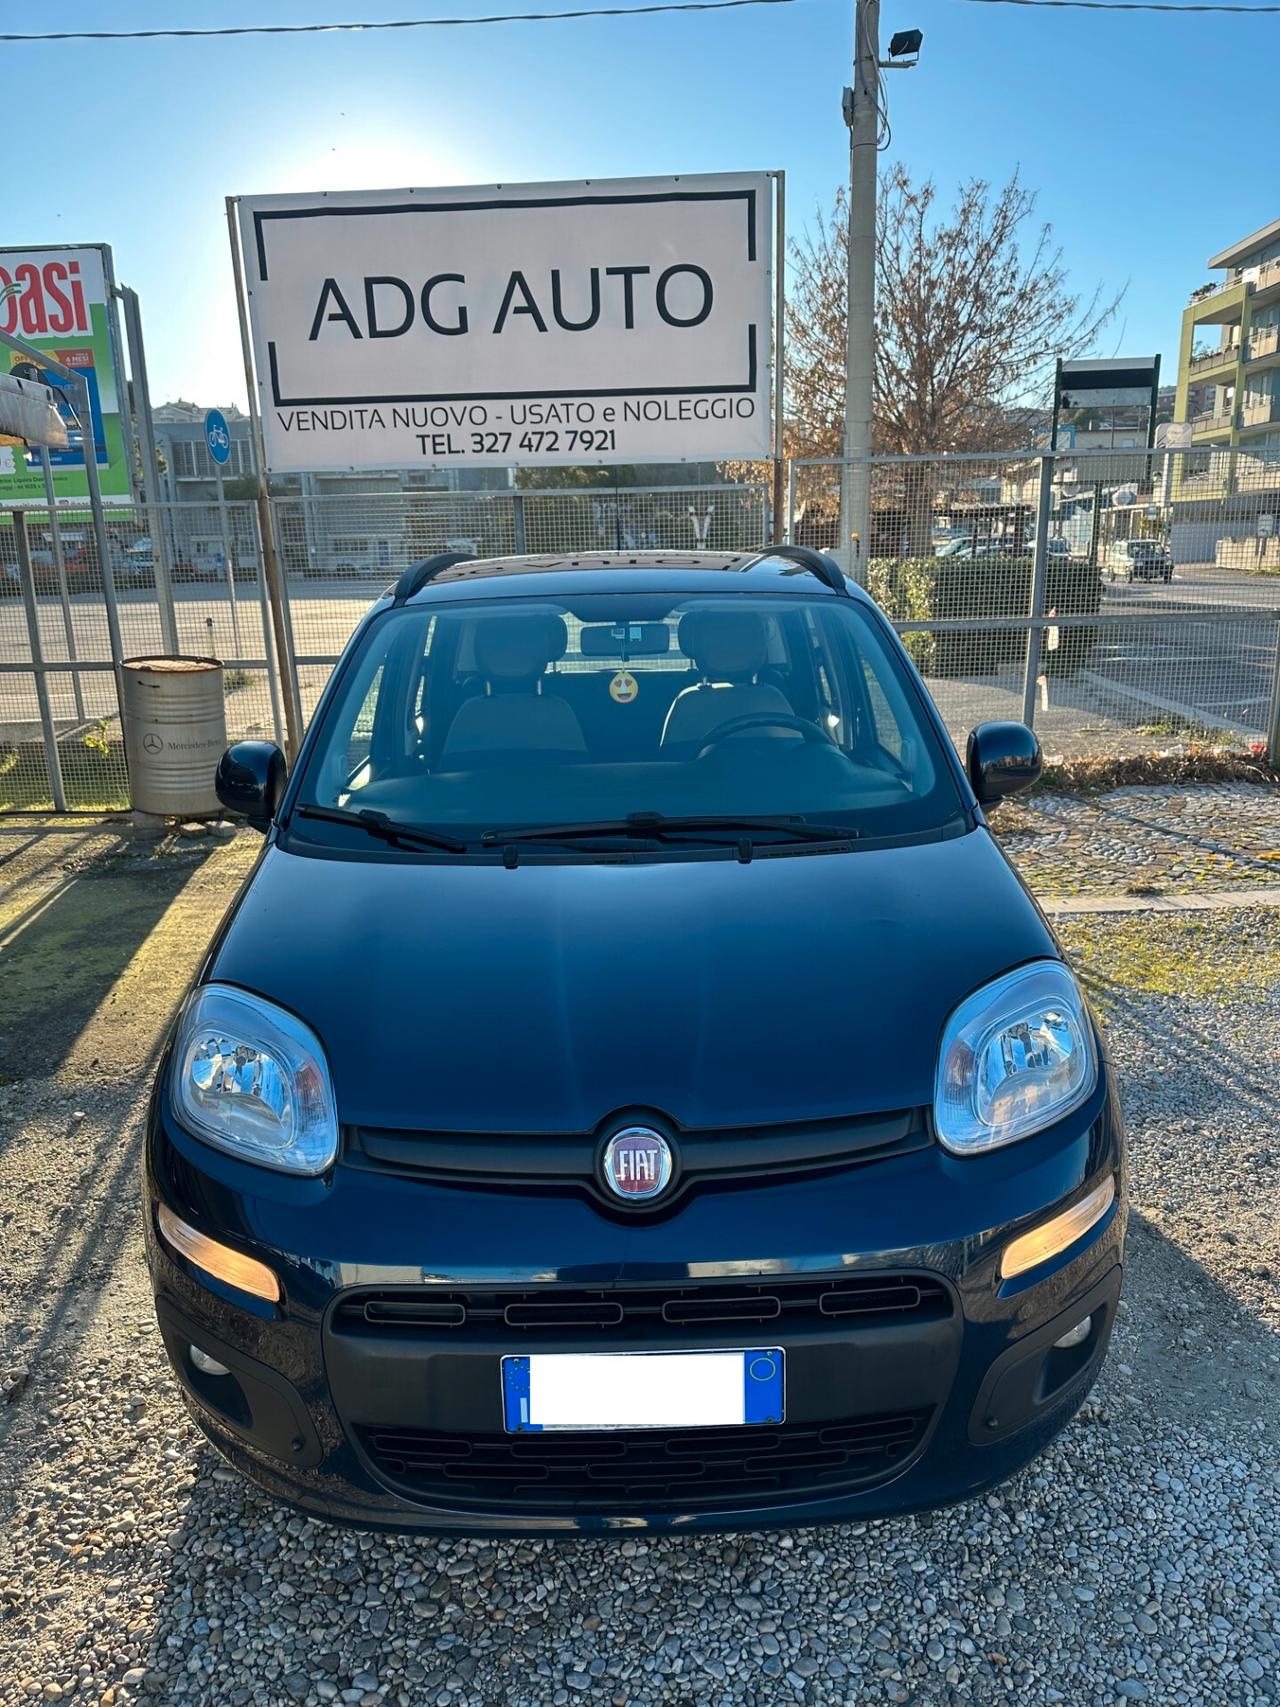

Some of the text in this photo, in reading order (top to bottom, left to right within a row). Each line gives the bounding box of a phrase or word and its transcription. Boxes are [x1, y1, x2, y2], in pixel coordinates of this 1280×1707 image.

[308, 263, 714, 341] ADG AUTO
[276, 408, 386, 432] VENDITA
[392, 405, 488, 428] NUOVO
[510, 402, 595, 425] USATO
[602, 407, 616, 423] e
[623, 397, 755, 422] NOLEGGIO
[415, 429, 616, 455] TEL. 327 472 7921
[619, 1149, 658, 1181] FIAT
